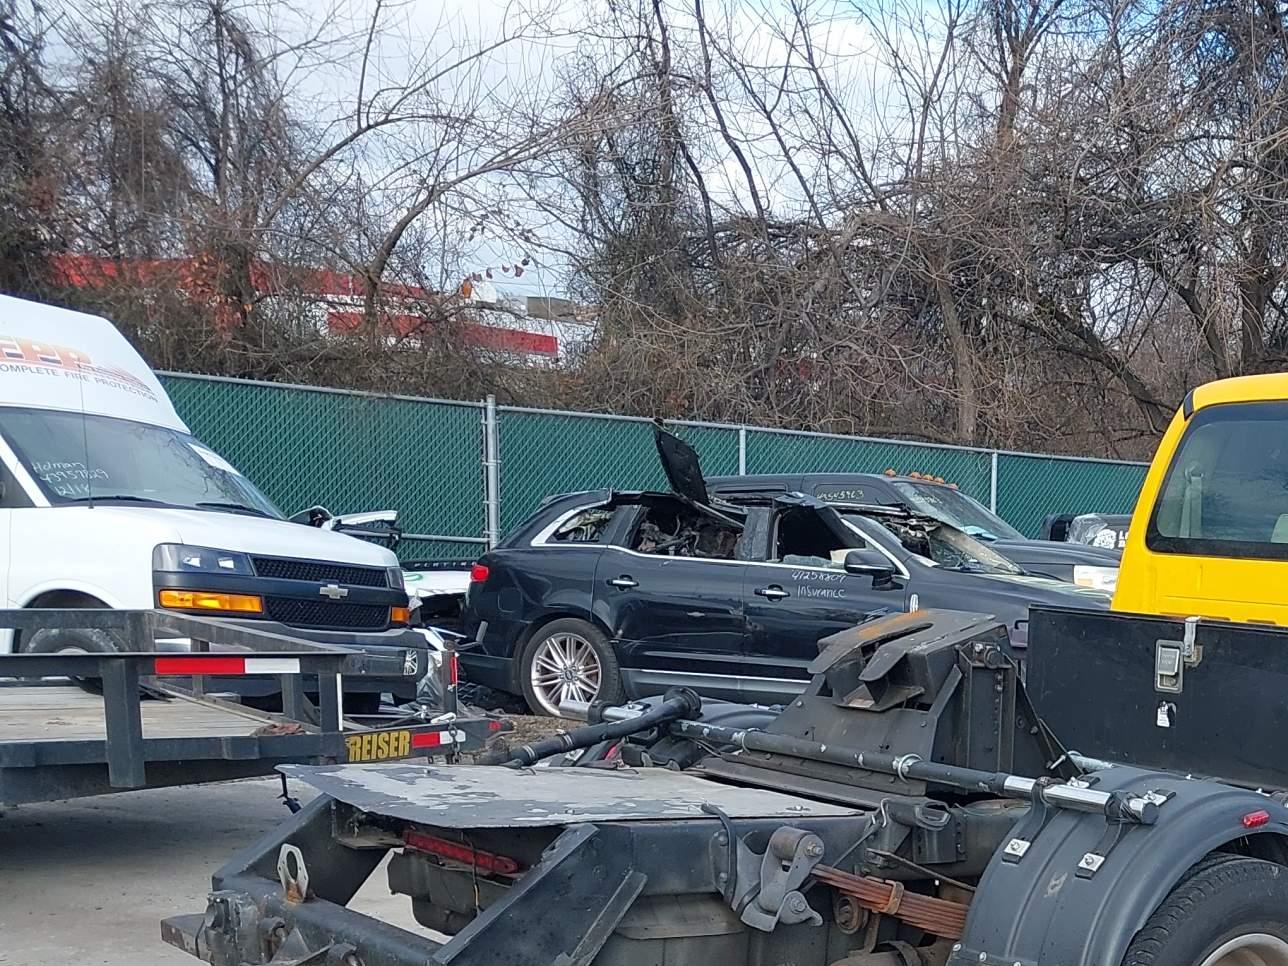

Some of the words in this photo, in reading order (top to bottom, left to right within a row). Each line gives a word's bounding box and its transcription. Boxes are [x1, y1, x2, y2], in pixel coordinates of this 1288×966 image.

[0, 363, 60, 377] OMPLETE
[64, 371, 90, 383] FIRE
[95, 377, 158, 403] PROTECTION
[797, 585, 847, 599] Insurance
[345, 729, 410, 763] REISER
